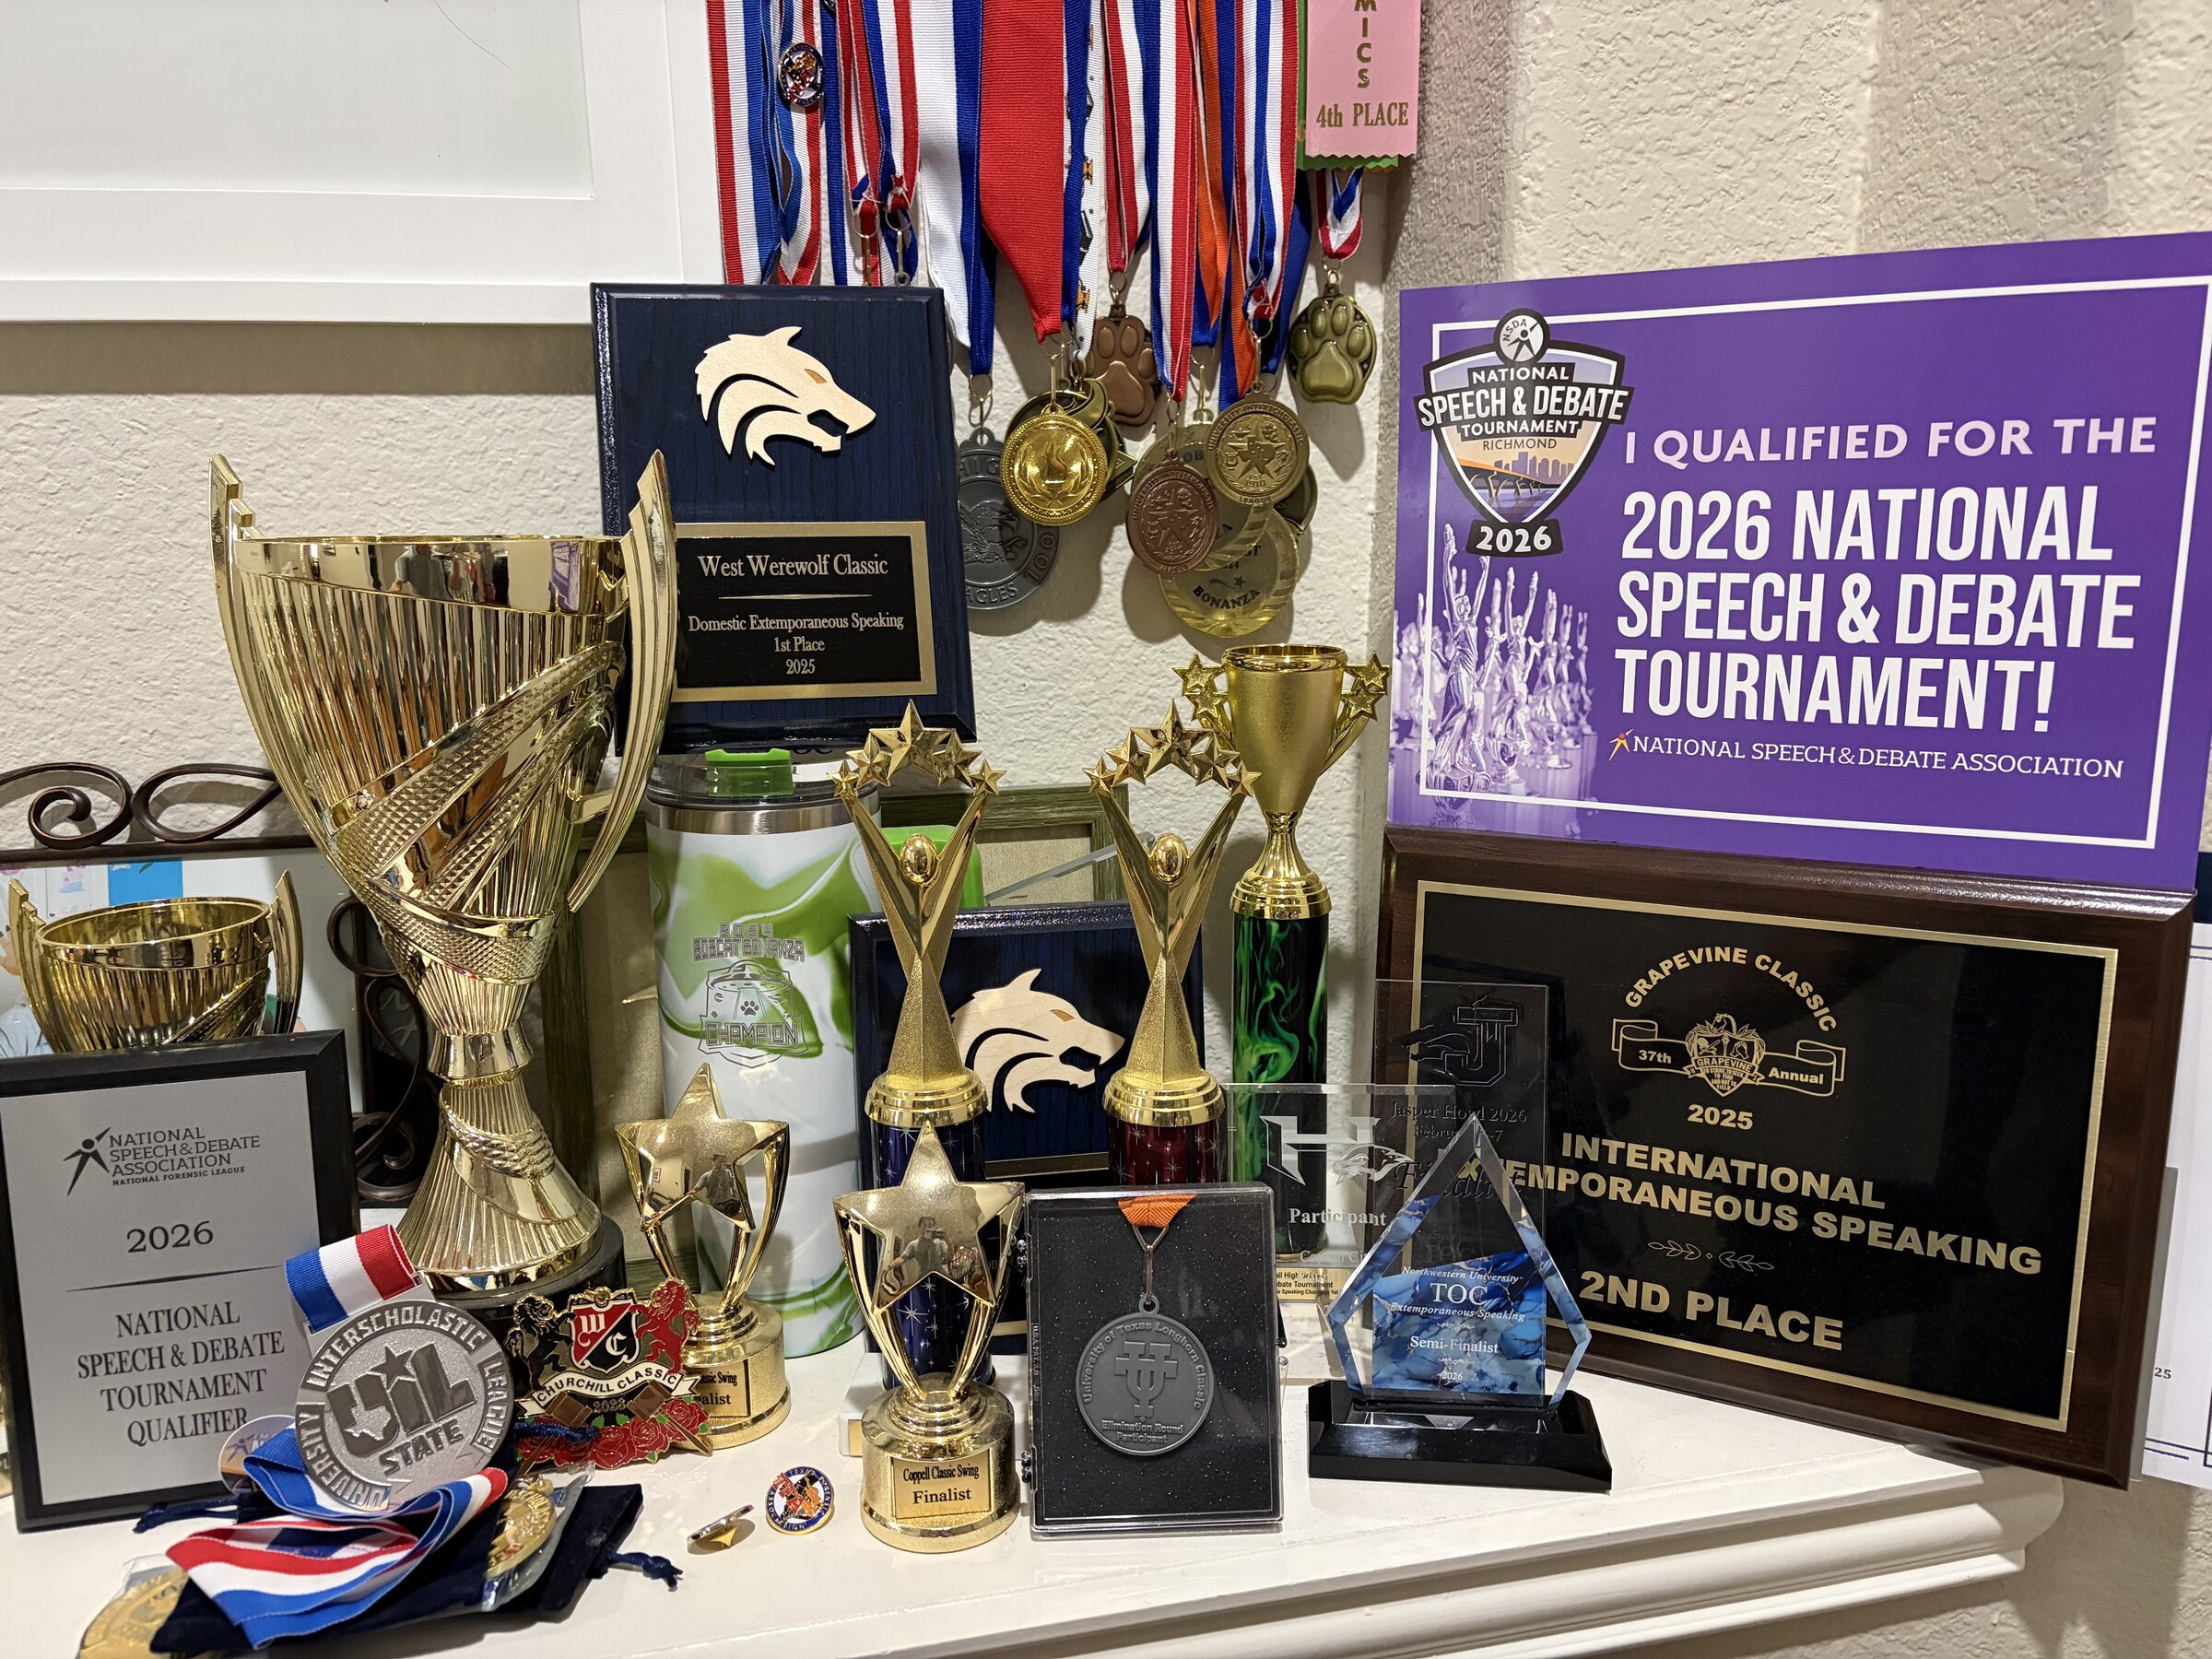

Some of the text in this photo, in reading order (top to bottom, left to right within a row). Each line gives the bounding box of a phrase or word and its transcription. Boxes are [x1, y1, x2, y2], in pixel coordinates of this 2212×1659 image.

[1316, 102, 1409, 128] 4th PLACE
[1502, 318, 1528, 343] NSDA
[1472, 366, 1570, 384] NATIONAL
[1418, 385, 1630, 427] SPEECH & DEBATE
[1461, 419, 1580, 438] TOURNAMENT
[1207, 404, 1304, 504] UNIVERSITY INTERSCHOLASTIC LEAGUE
[1482, 438, 1558, 451] RICHMOND
[1625, 417, 2157, 470] I QUALIFIED FOR THE
[1620, 486, 2113, 561] 2026 NATIONAL
[1476, 525, 1552, 553] 2026
[698, 553, 889, 578] West Werewolf Classic
[1193, 585, 1261, 609] BONANZA
[1618, 571, 2142, 649] SPEECH & DEBATE
[688, 612, 905, 635] Domestic Extemporaneous Speaking
[774, 637, 826, 653] 1st Place
[785, 659, 816, 675] 2025
[1614, 649, 2057, 733] TOURNAMENT!
[1632, 735, 1746, 760] NATIONAL
[1951, 751, 2124, 779] ASSOCIATION
[720, 922, 773, 938] 2024
[693, 936, 806, 963] BOBCAT BONANZA
[1625, 946, 1837, 1032] GRAPEVINE CLASSIC
[705, 1020, 799, 1047] CHAMPION
[1638, 1049, 1824, 1085] 37th Annual
[1697, 1057, 1753, 1073] GRAPEVINE
[1392, 1100, 1439, 1122] Jasper
[1488, 1108, 1527, 1123] 2026
[1687, 1104, 1753, 1130] 2025
[110, 1127, 206, 1148] NATIONAL
[112, 1153, 231, 1178] ASSOCIATION
[112, 1166, 246, 1186] NATIONAL FORENSIC LEAGUE
[1562, 1133, 1886, 1209] INTERNATIONAL
[1288, 1207, 1387, 1227] Participant
[126, 1220, 214, 1253] 2026
[1812, 1209, 2043, 1276] SPEAKING
[1402, 1265, 1520, 1285] Northwestern University
[1430, 1282, 1488, 1306] TOC
[115, 1300, 241, 1337] NATIONAL
[1390, 1301, 1526, 1323] Extemporaneous Speaking
[1579, 1270, 1844, 1351] 2ND PLACE
[77, 1331, 285, 1379] SPEECH & DEBATE
[1410, 1335, 1500, 1354] Semi-Finalist
[1082, 1321, 1207, 1409] University of Texas Longhorn Classic
[1441, 1371, 1464, 1381] 2026
[100, 1369, 267, 1412] TOURNAMENT
[536, 1367, 677, 1404] CHURCHILL CLASSIC
[717, 1371, 738, 1386] Swing
[298, 1305, 507, 1507] UNIVERSITY INTERSCHOLASTIC LEAGUE
[593, 1399, 626, 1414] 2023
[127, 1407, 248, 1447] QUALIFIER
[1101, 1419, 1184, 1434] Elimination Round
[1116, 1431, 1169, 1444] Participant
[379, 1418, 464, 1476] STATE
[903, 1463, 979, 1484] Coppell Classic Swing
[912, 1488, 971, 1504] Finalist
